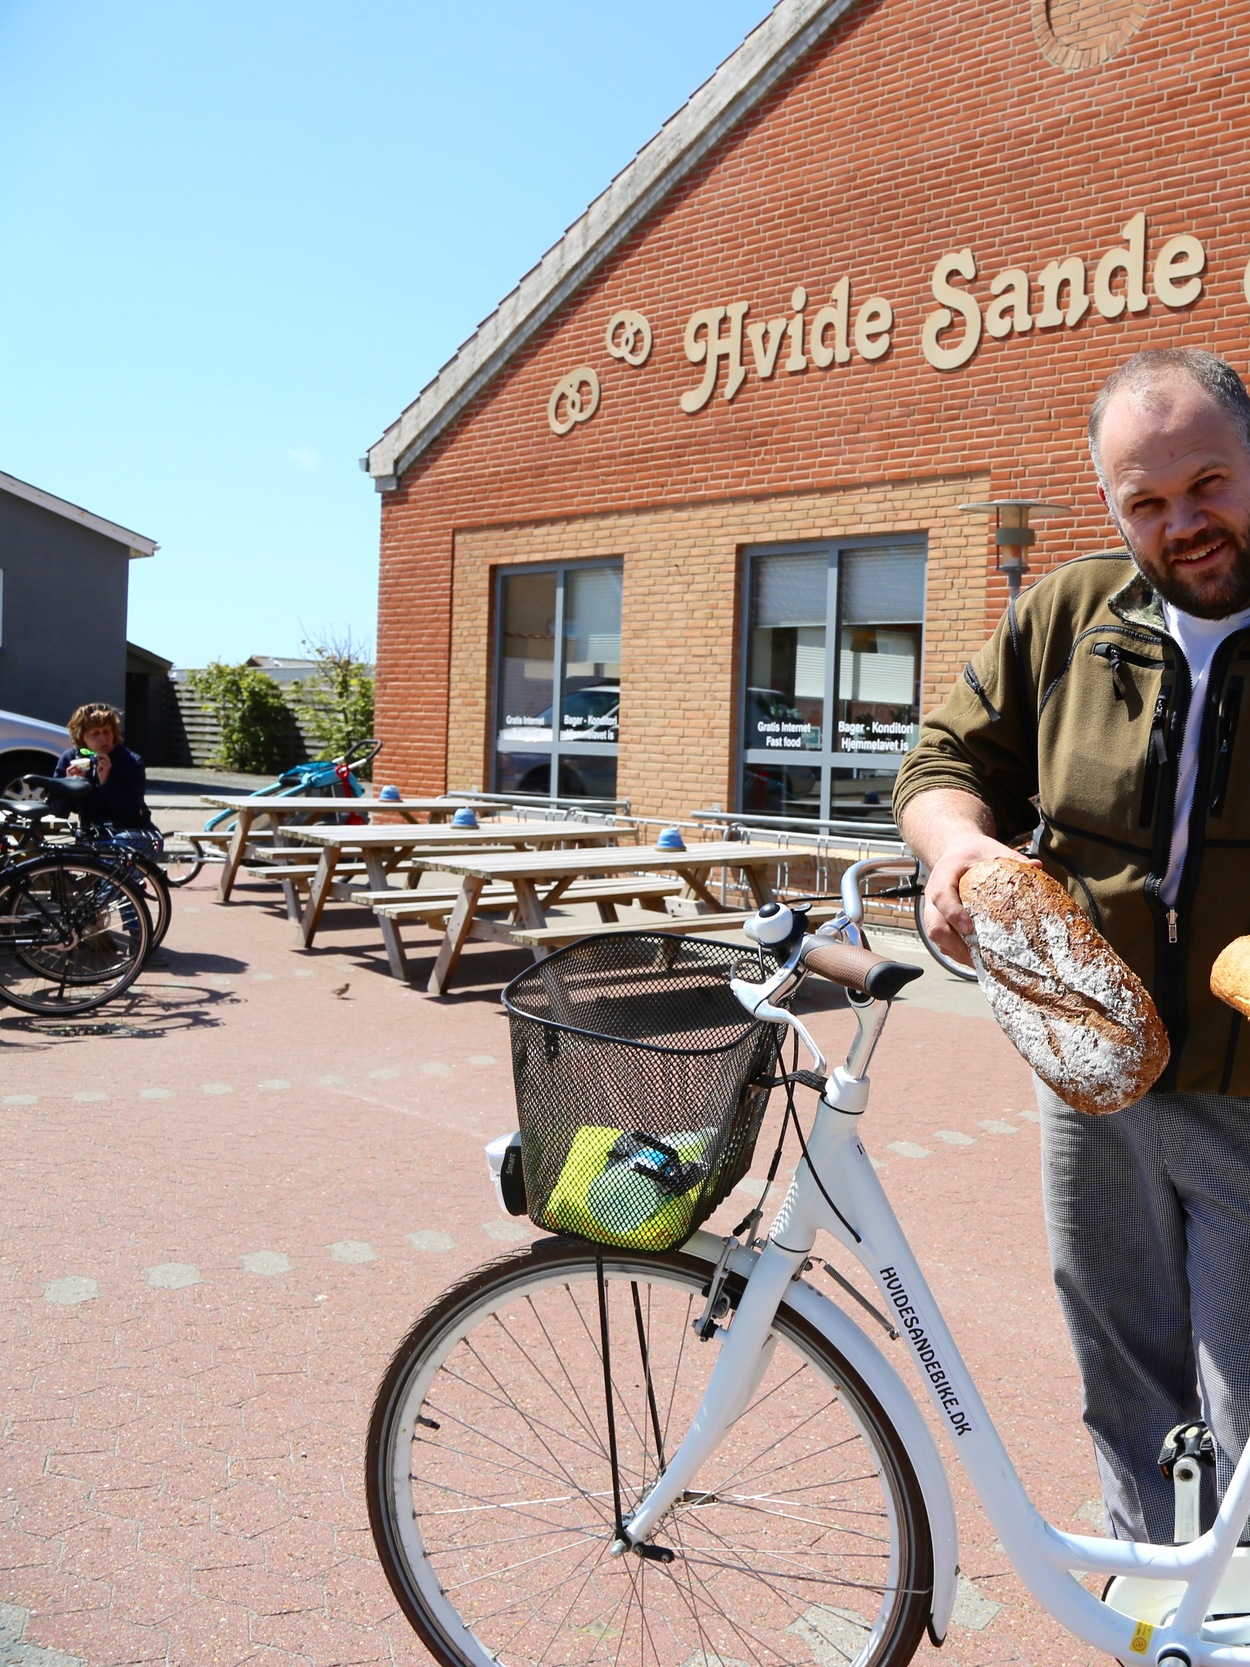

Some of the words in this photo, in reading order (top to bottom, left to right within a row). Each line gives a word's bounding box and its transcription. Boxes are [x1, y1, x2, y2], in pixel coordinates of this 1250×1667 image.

[680, 276, 894, 413] Hvide
[921, 212, 1206, 370] Sande
[506, 715, 522, 725] Gratis
[523, 715, 545, 726] Internet
[563, 714, 583, 727] Bager
[587, 715, 618, 726] Konditori
[757, 721, 780, 732] Gratis
[781, 722, 812, 733] Internet
[838, 721, 865, 734] Bager
[871, 722, 914, 734] Konditori
[766, 736, 783, 747] Fast
[784, 736, 801, 748] food
[841, 737, 899, 752] Hjemmelavet
[901, 739, 909, 751] is
[506, 1153, 516, 1175] Smart
[880, 1266, 972, 1437] HVIDESANDEBIKE.DK
